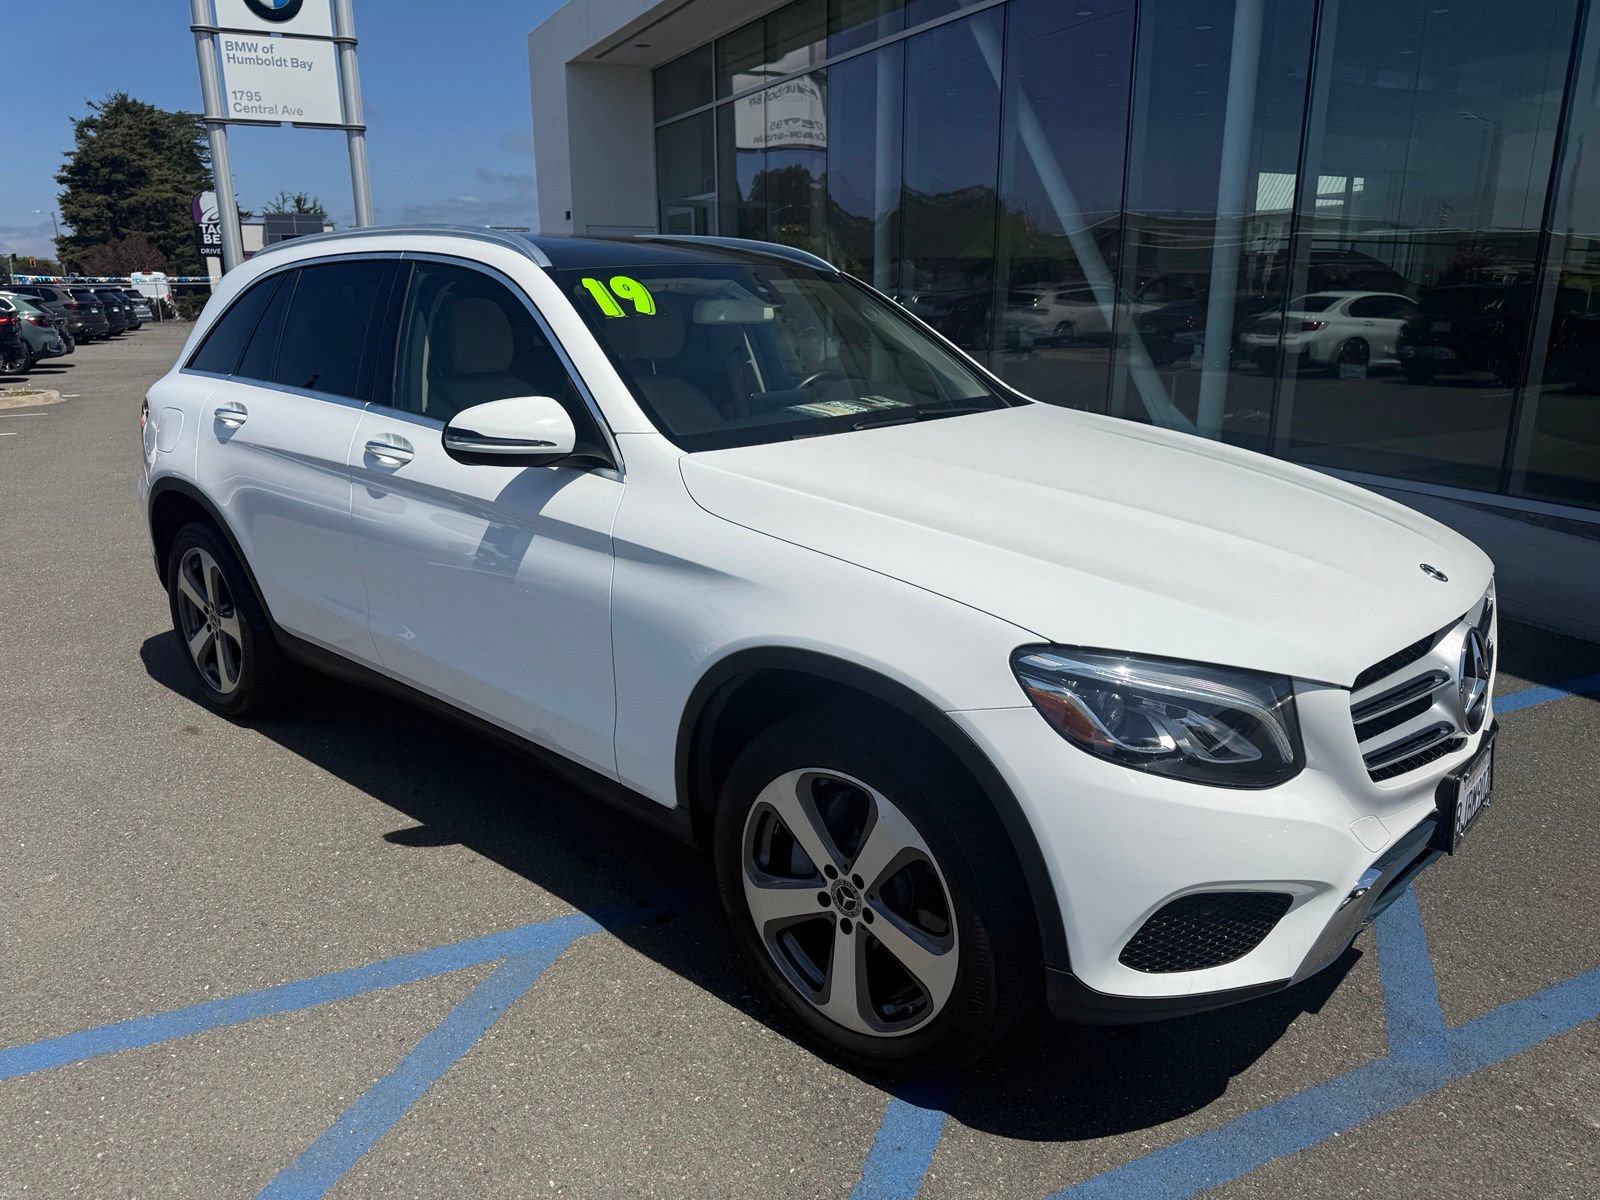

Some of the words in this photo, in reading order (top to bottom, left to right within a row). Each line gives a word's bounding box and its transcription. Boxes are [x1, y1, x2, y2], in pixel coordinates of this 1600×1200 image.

[225, 41, 258, 52] BMW
[262, 44, 274, 54] of
[226, 53, 288, 68] Humboldt
[291, 58, 313, 71] Bay
[231, 90, 261, 102] 1795
[233, 102, 277, 115] Central
[281, 105, 303, 116] Ave
[203, 234, 221, 244] BE
[581, 275, 657, 317] 19
